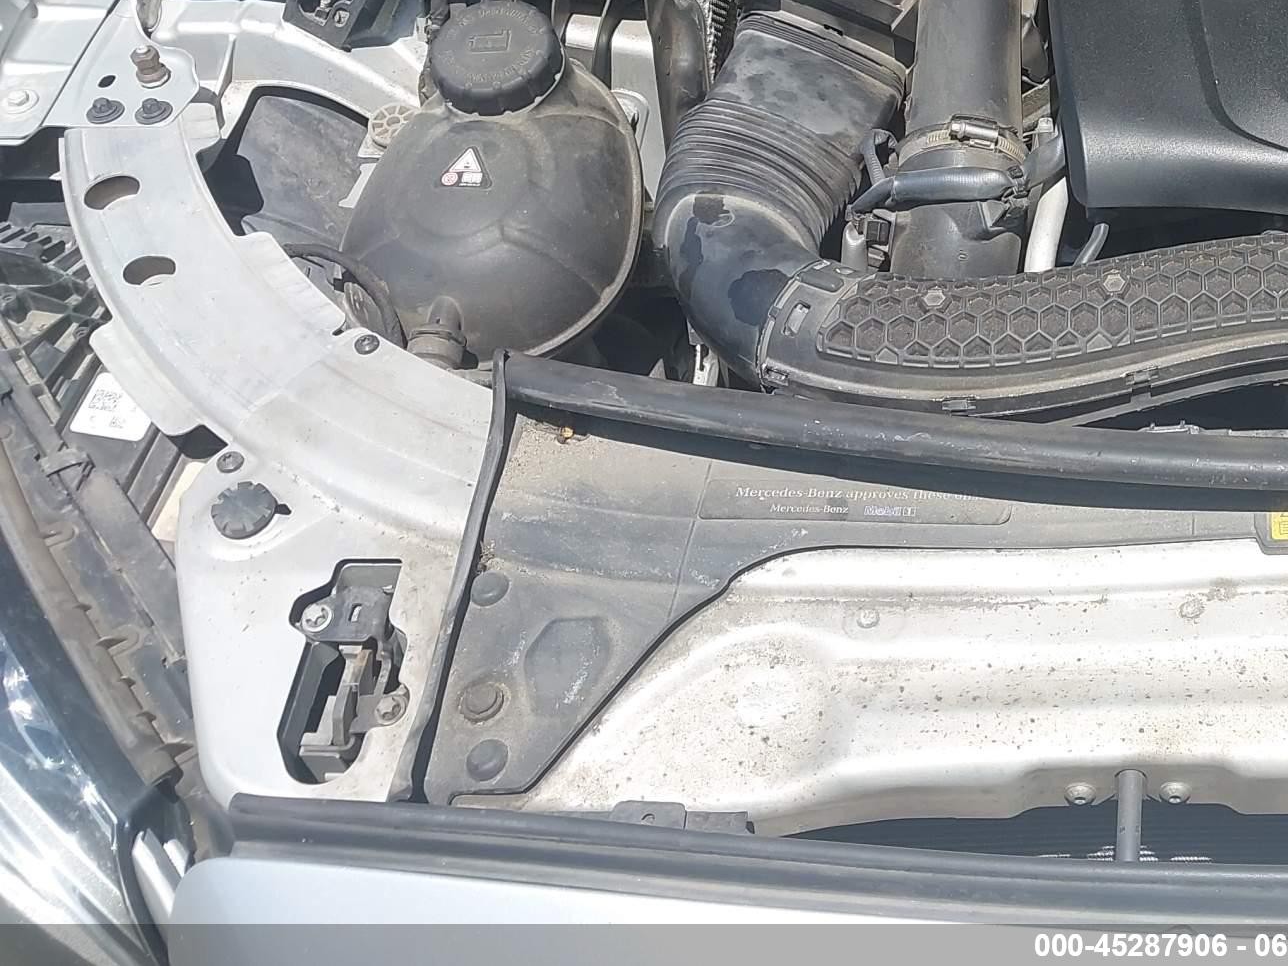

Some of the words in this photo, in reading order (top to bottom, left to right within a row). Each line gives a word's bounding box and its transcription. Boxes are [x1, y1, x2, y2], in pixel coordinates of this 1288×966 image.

[736, 486, 843, 500] Mercedes-Benz
[846, 489, 909, 501] approves
[769, 503, 849, 514] Mercedes-Benz
